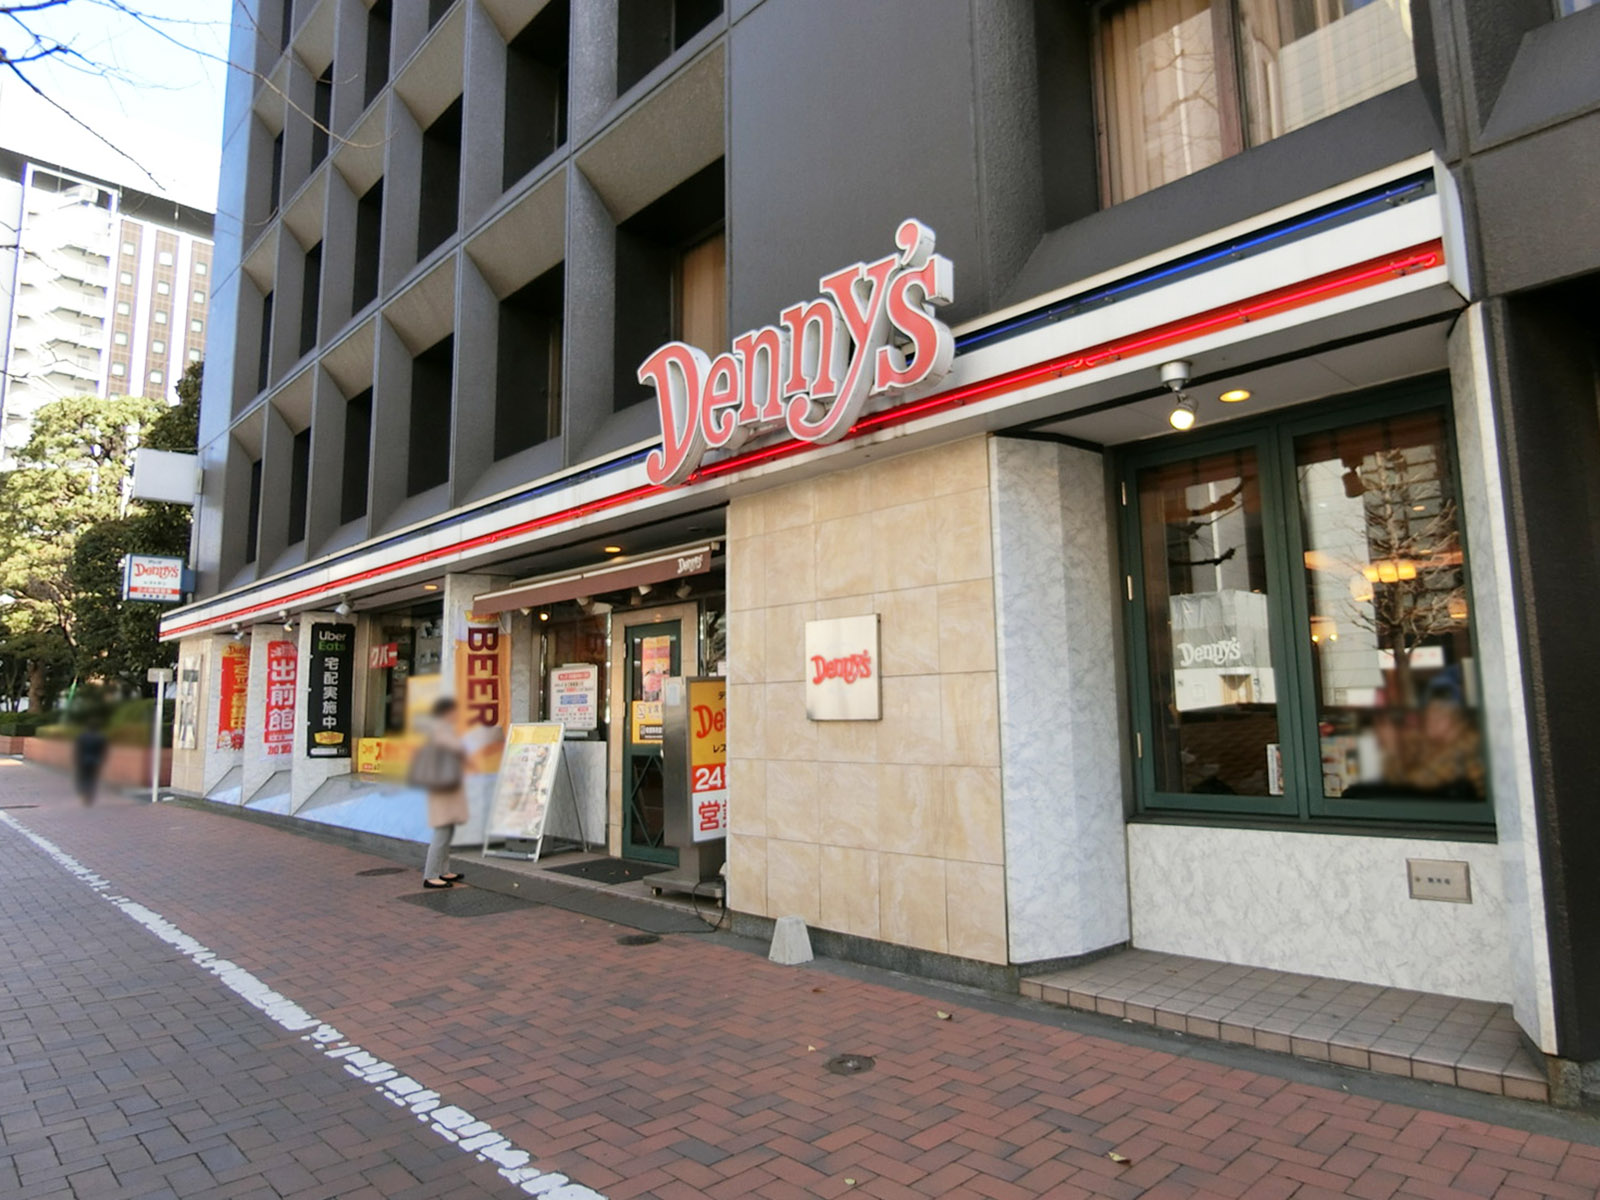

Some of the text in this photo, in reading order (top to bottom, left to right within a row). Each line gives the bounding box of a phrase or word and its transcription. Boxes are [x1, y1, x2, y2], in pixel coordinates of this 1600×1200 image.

[638, 219, 953, 485] Denny's
[134, 563, 179, 579] Denny's
[318, 641, 345, 651] Eats
[319, 631, 346, 641] Uber
[1177, 637, 1241, 667] Denny's
[467, 627, 499, 728] BEER
[810, 649, 872, 685] Denny's
[268, 660, 296, 731] 出前館
[322, 657, 339, 728] 宅配実施中
